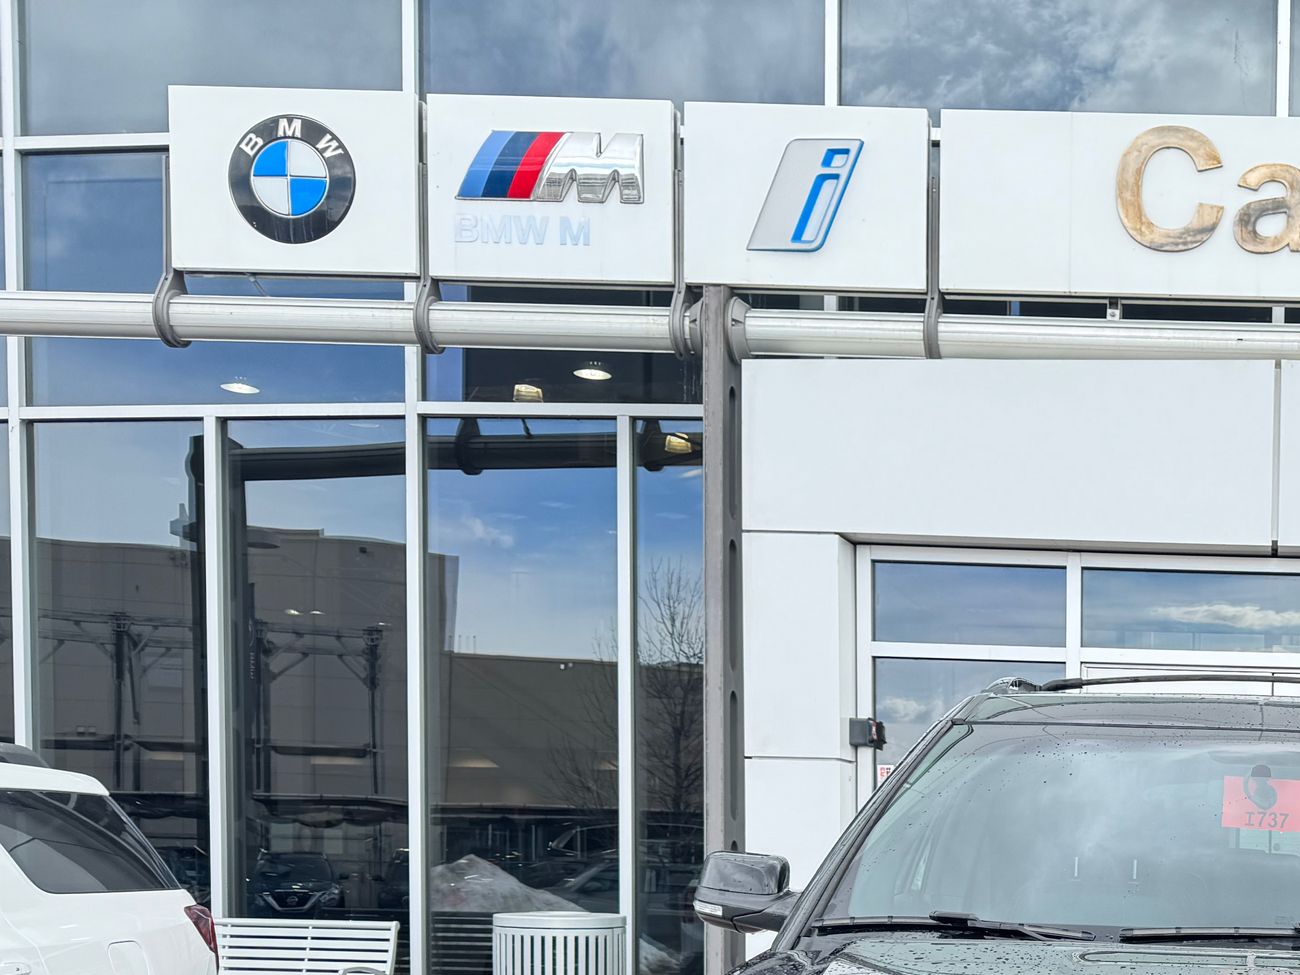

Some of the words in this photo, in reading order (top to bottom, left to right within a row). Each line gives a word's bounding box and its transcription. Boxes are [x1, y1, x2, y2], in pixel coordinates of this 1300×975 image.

[239, 117, 345, 159] BMW
[454, 213, 550, 245] BMW
[559, 215, 591, 246] M
